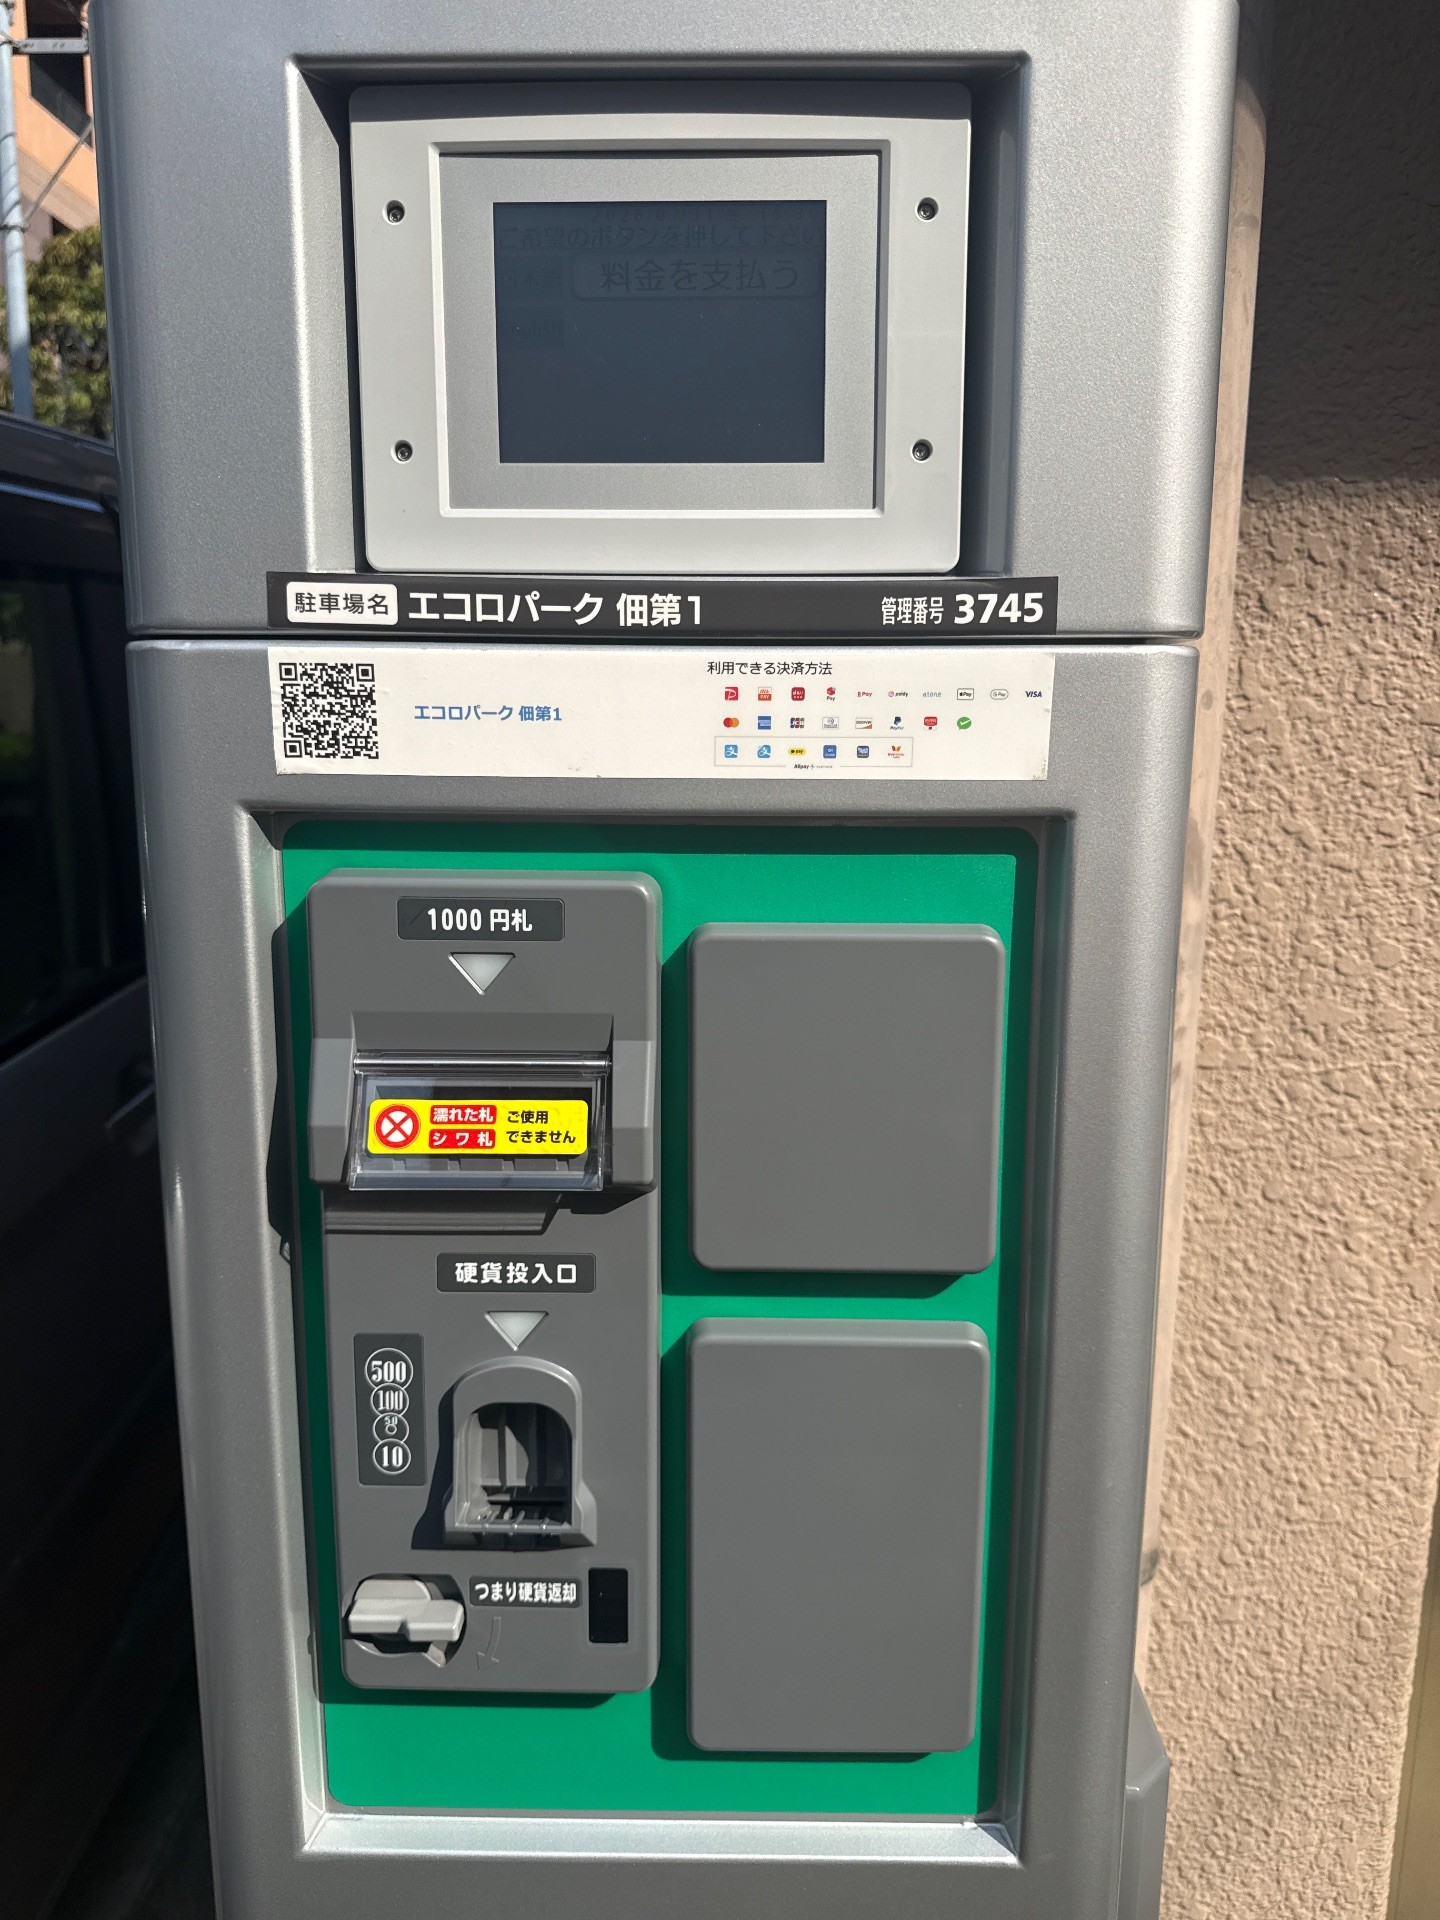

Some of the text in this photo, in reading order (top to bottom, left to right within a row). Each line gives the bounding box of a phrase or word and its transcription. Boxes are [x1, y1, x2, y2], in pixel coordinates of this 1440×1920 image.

[600, 258, 799, 292] 料金を支払う
[294, 591, 390, 616] 駐車場名
[408, 589, 701, 626] エコロパーク 佃第1
[881, 592, 1044, 626] 管理番号 3745
[706, 661, 833, 676] 利用できる決済方法
[922, 690, 942, 698] atone
[1025, 690, 1043, 698] VISA
[414, 704, 562, 722] エコロパーク 佃第1
[427, 908, 533, 933] 1000 円札
[432, 1107, 494, 1124] 濡れた札
[506, 1110, 549, 1125] ご使用
[432, 1131, 494, 1147] シワ札
[505, 1129, 577, 1144] できません
[454, 1262, 578, 1285] 硬貨投入口
[371, 1360, 407, 1383] 500
[377, 1389, 404, 1411] 100
[384, 1415, 398, 1425] 50
[381, 1445, 404, 1468] 10
[474, 1581, 578, 1604] つまり硬貨返却
